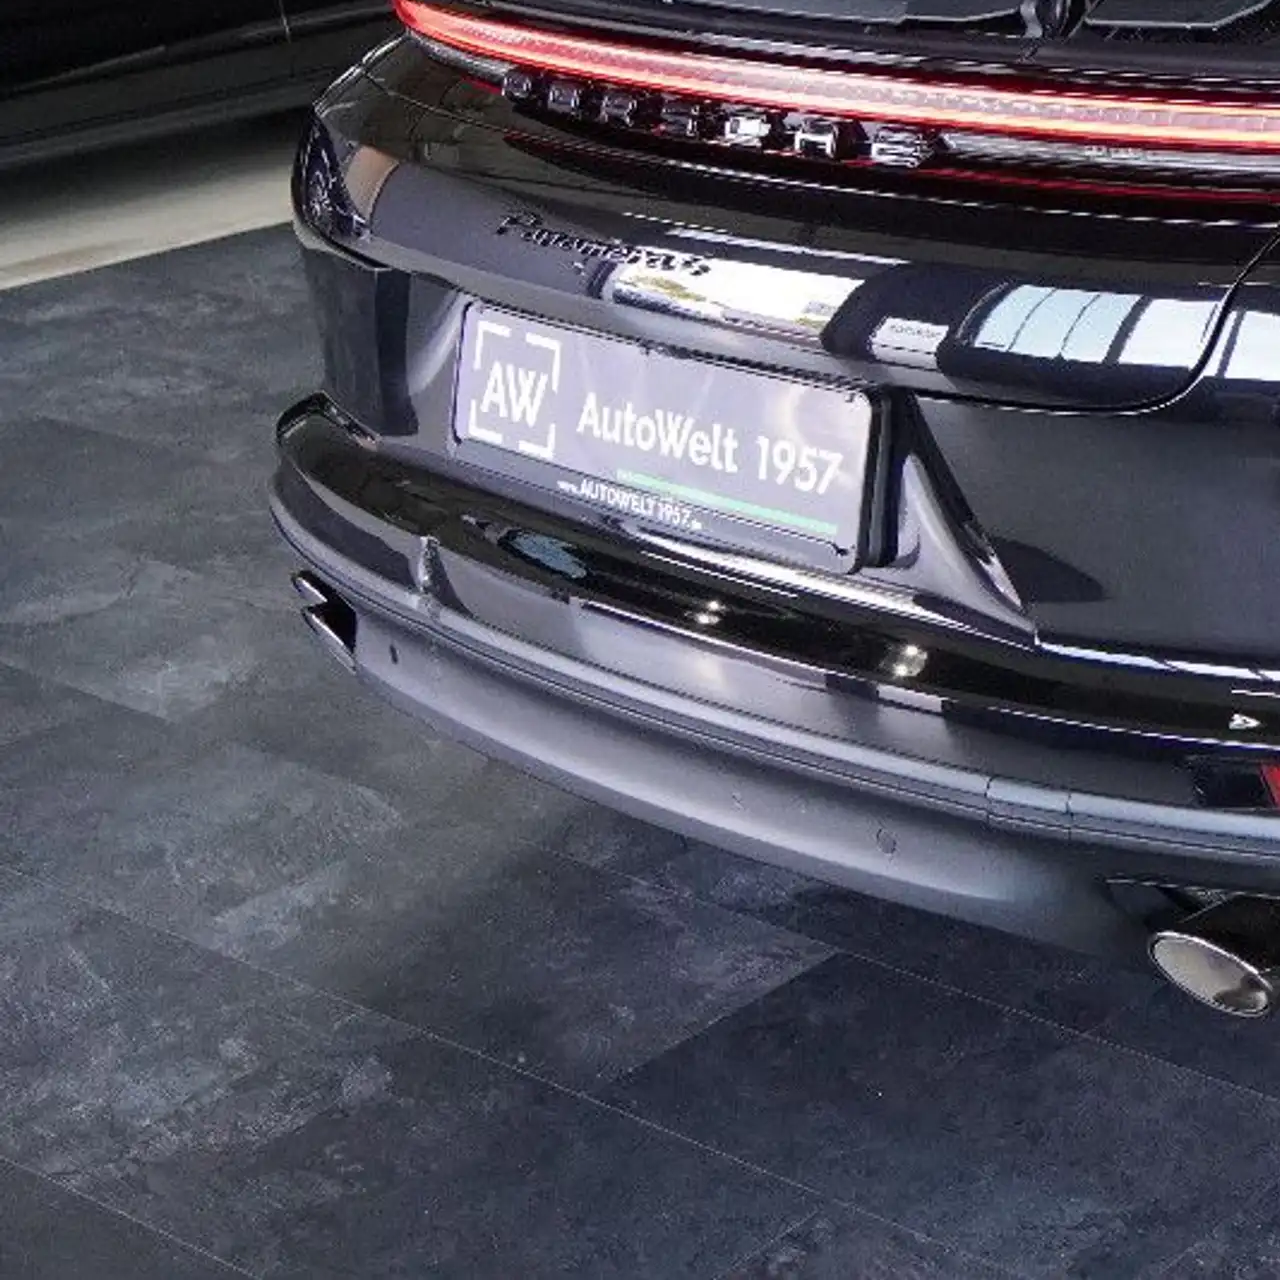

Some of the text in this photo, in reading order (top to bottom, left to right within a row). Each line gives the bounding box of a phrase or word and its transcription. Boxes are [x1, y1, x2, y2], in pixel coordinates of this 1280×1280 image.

[480, 361, 549, 428] AW
[576, 392, 844, 496] AutoWelt 1957
